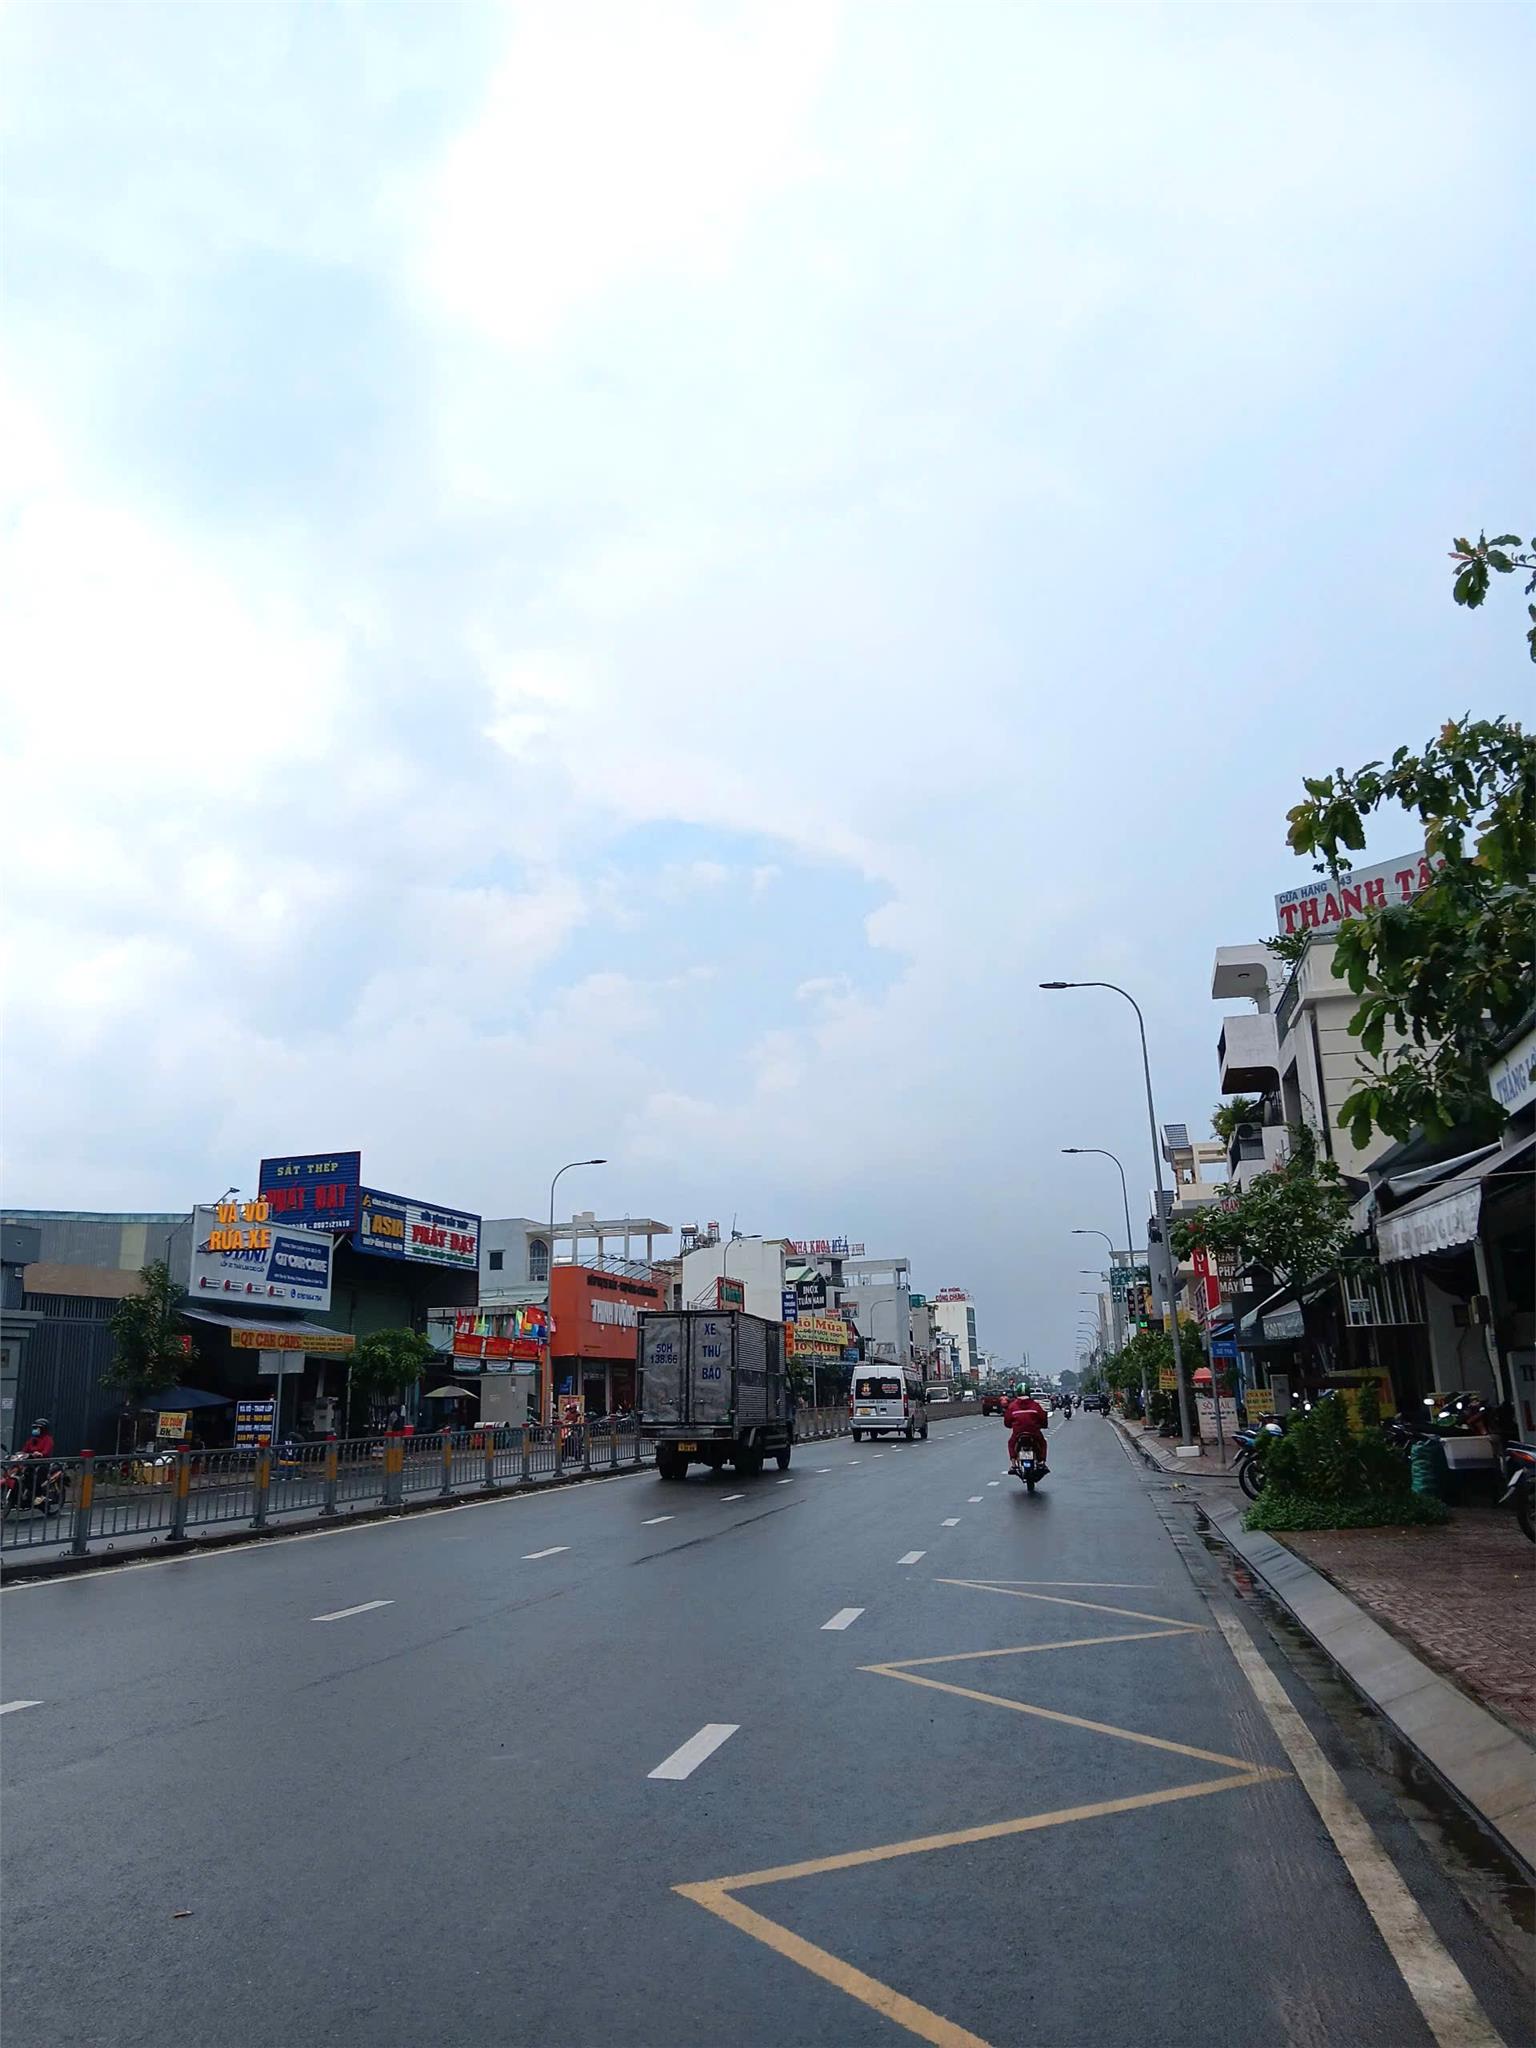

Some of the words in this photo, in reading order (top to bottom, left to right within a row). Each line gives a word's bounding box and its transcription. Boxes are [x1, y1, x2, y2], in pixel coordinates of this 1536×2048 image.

[1279, 878, 1388, 934] THANH
[1395, 857, 1447, 901] TÂ
[1301, 882, 1327, 898] HÀNG
[372, 1215, 405, 1239] ASIA
[247, 1228, 273, 1249] XE
[411, 1223, 447, 1248] PHÁT
[449, 1232, 476, 1255] ĐẠT
[810, 1240, 831, 1254] KHOA
[802, 1285, 819, 1294] INOX
[1219, 1278, 1239, 1292] MÁY
[704, 1323, 716, 1335] XE
[656, 1343, 673, 1353] 50H
[702, 1343, 722, 1357] THƯ
[650, 1354, 678, 1364] 138.66
